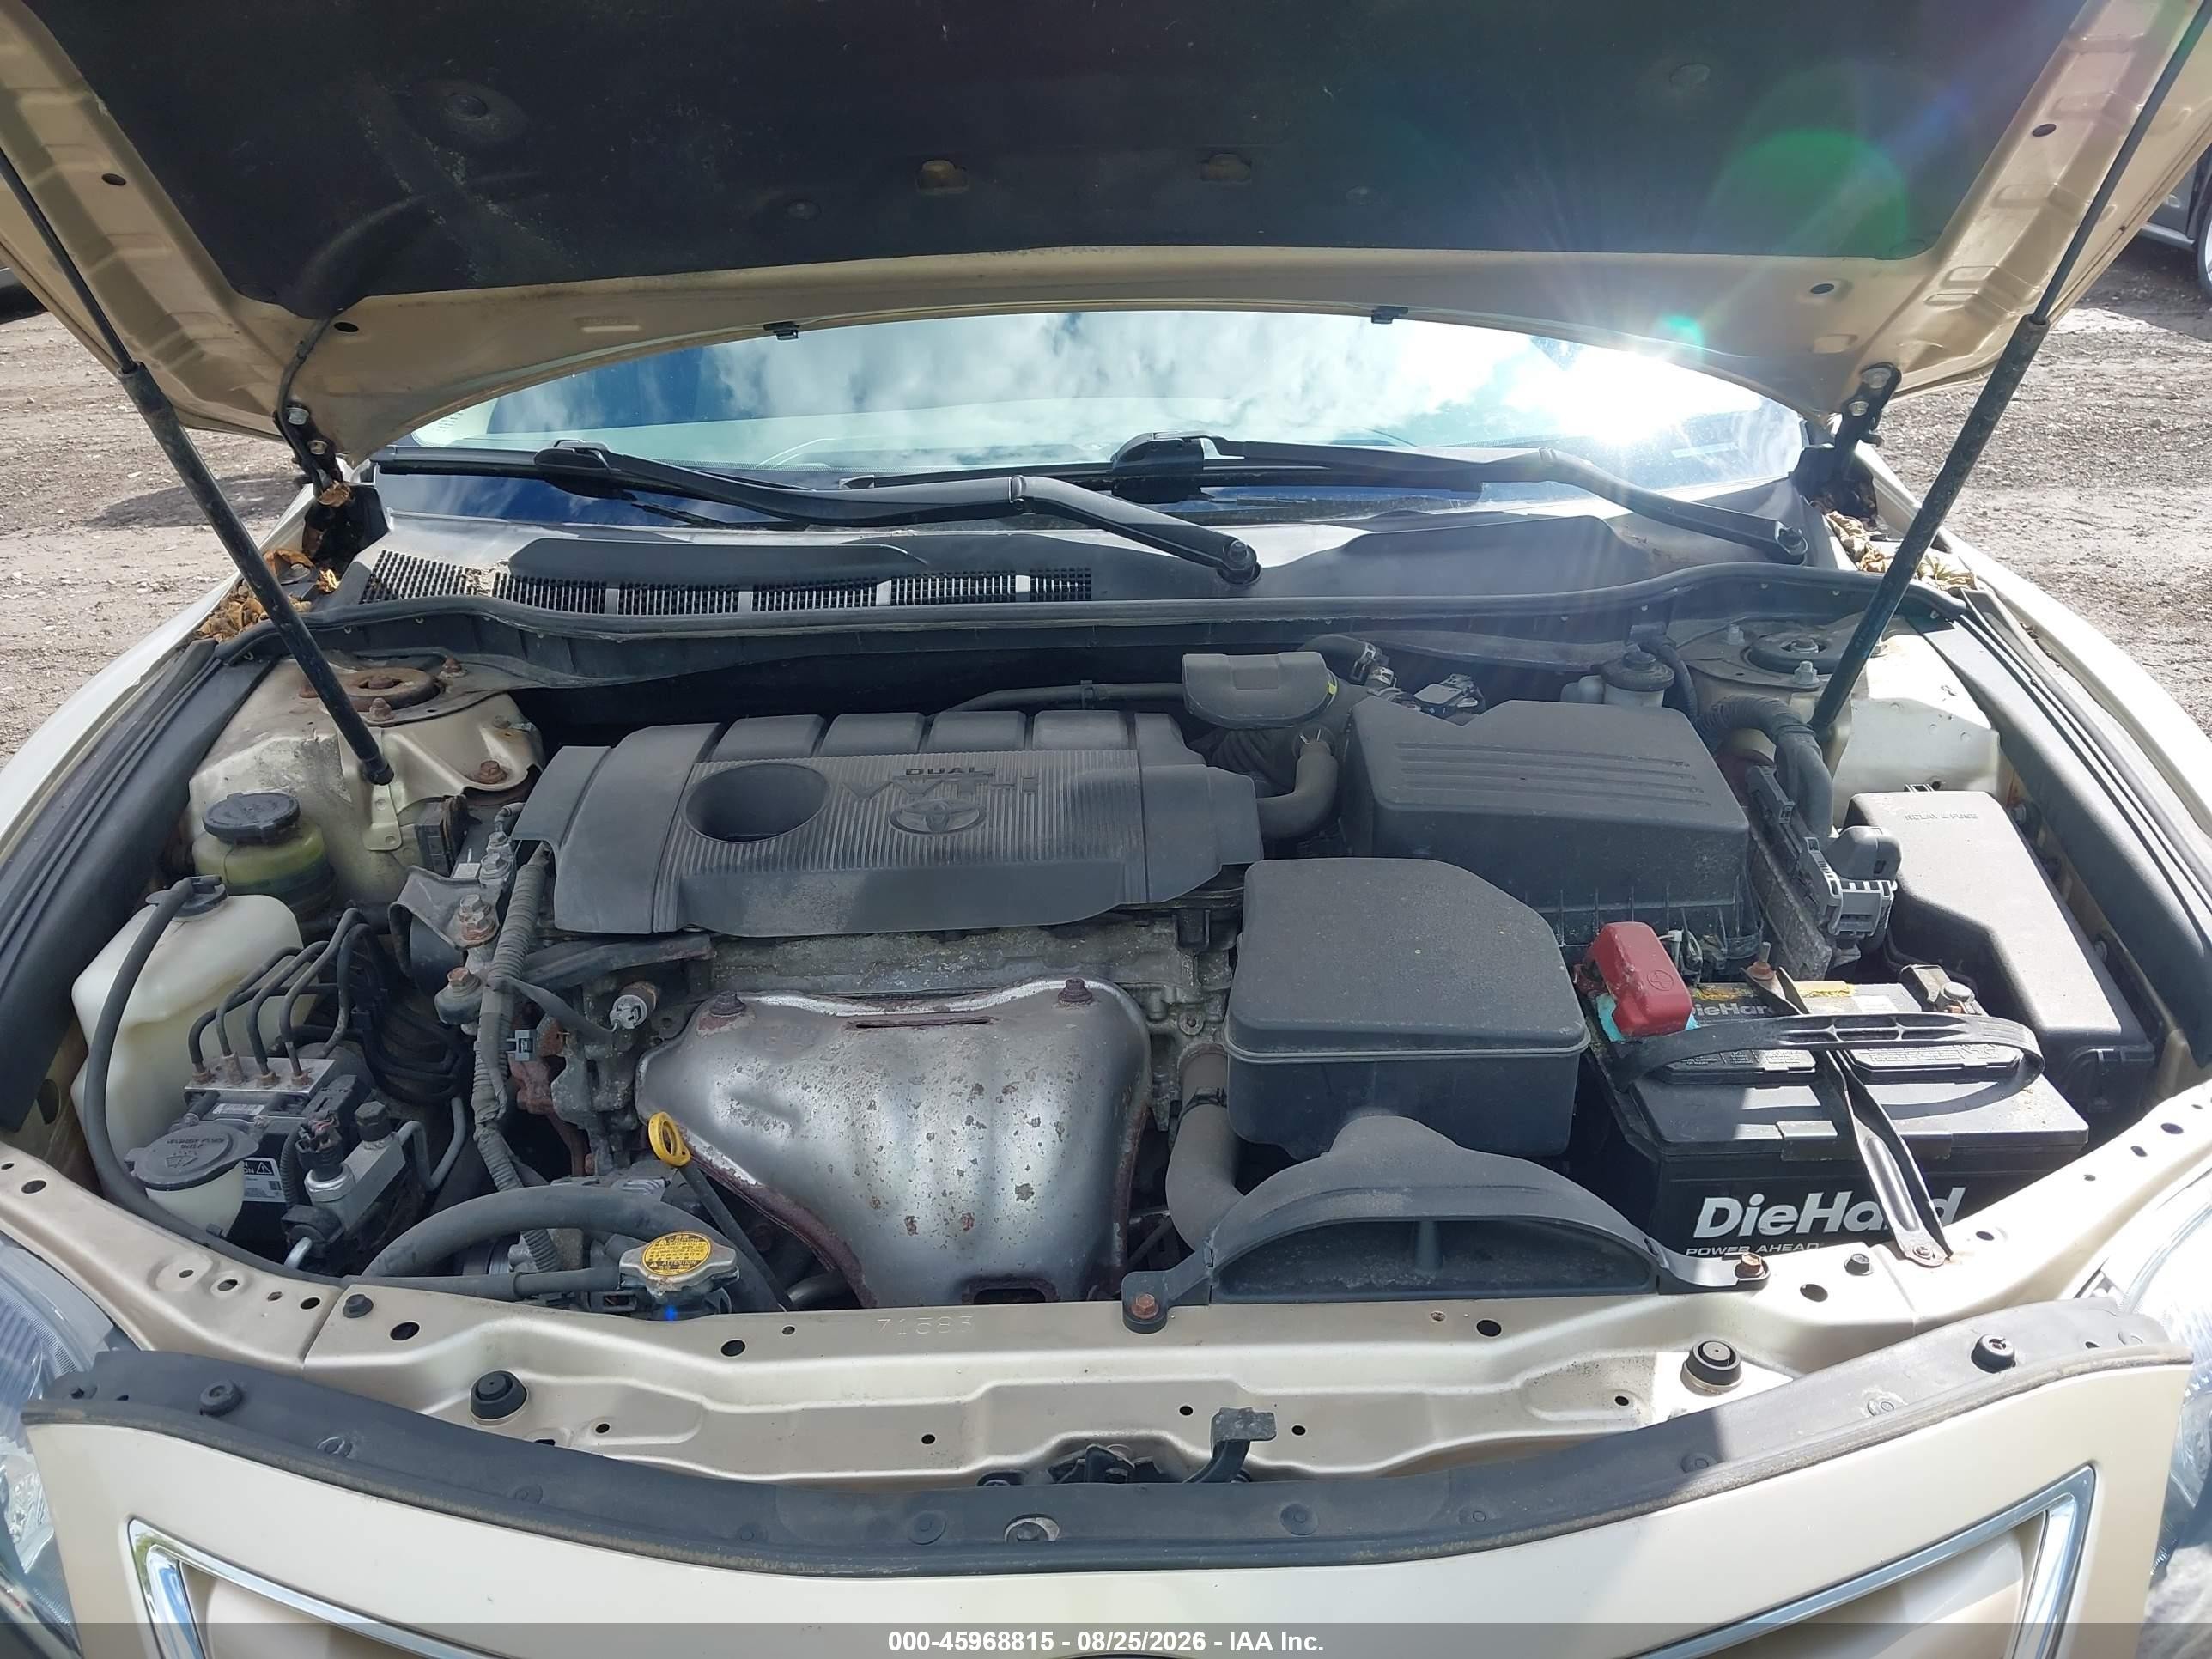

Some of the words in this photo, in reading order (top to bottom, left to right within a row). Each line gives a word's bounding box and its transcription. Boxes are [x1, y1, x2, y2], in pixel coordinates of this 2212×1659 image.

[905, 766, 994, 777] DUAL
[1692, 1000, 1774, 1016] ieHar
[1692, 1187, 1966, 1238] DieHad
[1686, 1246, 1751, 1256] POWER
